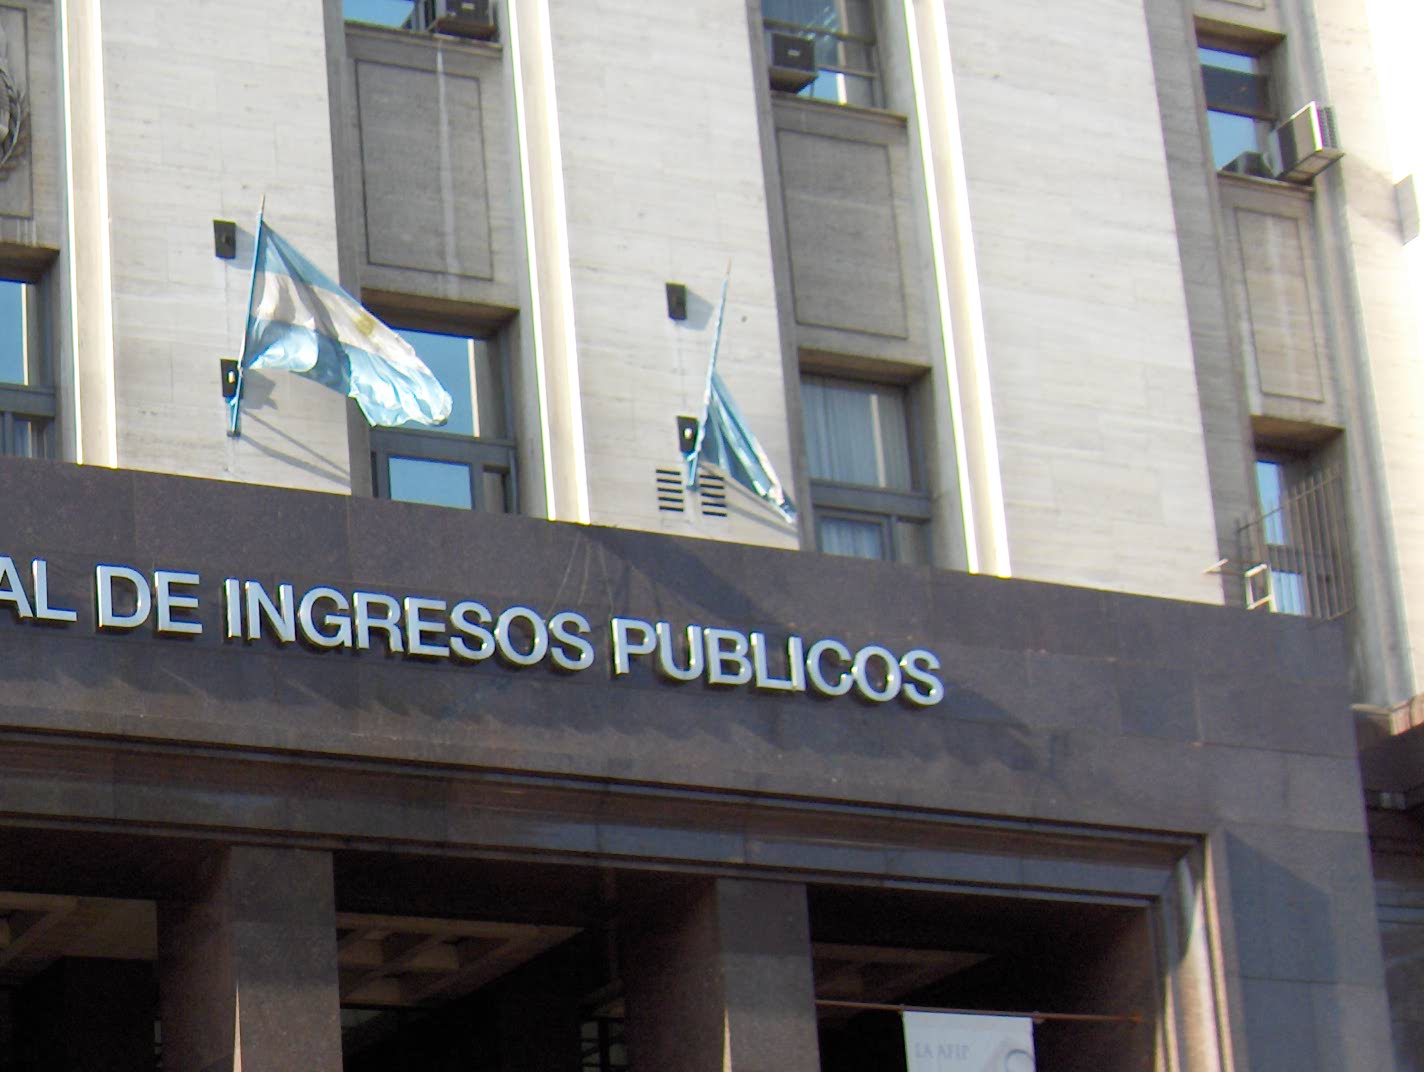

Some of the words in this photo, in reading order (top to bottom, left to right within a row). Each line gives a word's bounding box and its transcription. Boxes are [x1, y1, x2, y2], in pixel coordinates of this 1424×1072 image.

[95, 564, 203, 634] DE
[225, 577, 595, 671] INGRESOS
[611, 617, 945, 706] PUBLICOS
